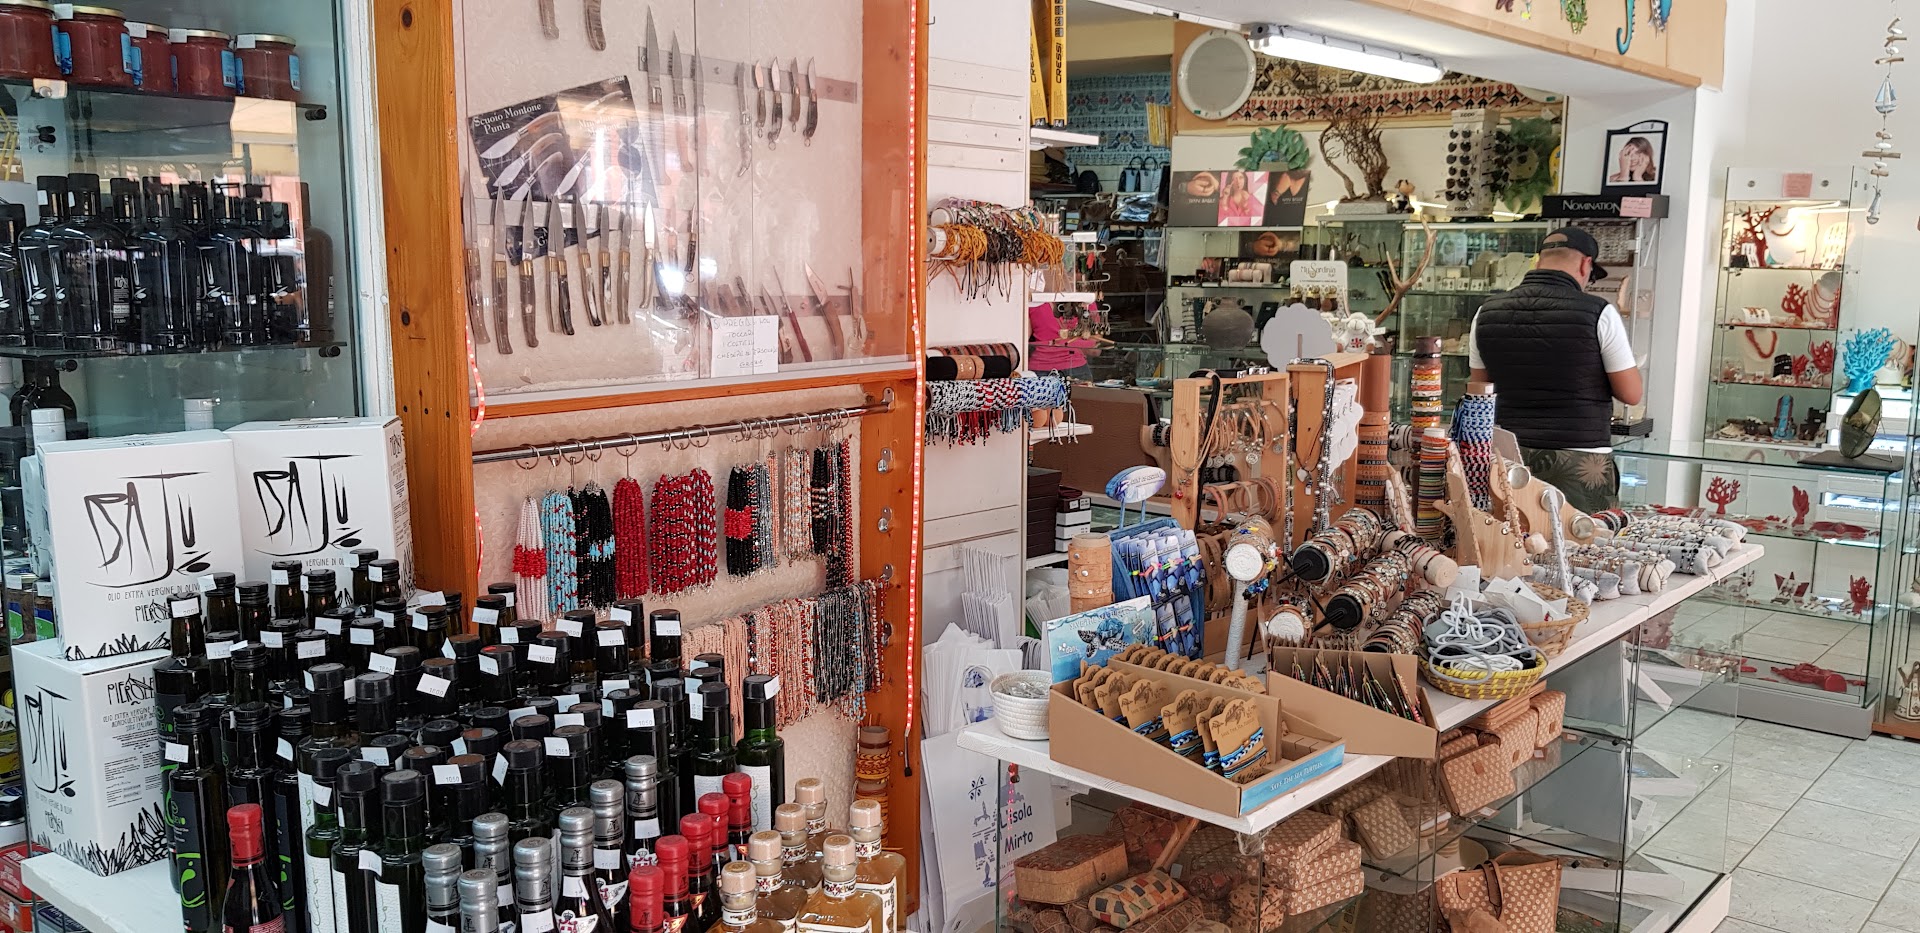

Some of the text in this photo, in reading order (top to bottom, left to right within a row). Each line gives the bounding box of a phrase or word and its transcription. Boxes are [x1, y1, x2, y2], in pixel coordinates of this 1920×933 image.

[472, 102, 541, 128] Scuoio Montone
[484, 122, 510, 135] Punta
[1562, 200, 1621, 214] NOMINATION
[305, 558, 329, 567] VERGINE
[107, 593, 121, 601] OLIO
[124, 590, 144, 599] EXTRA
[147, 586, 174, 597] VERGINE
[185, 582, 200, 592] OLIV
[1000, 803, 1033, 828] L'isola
[1004, 831, 1034, 854] Mirto
